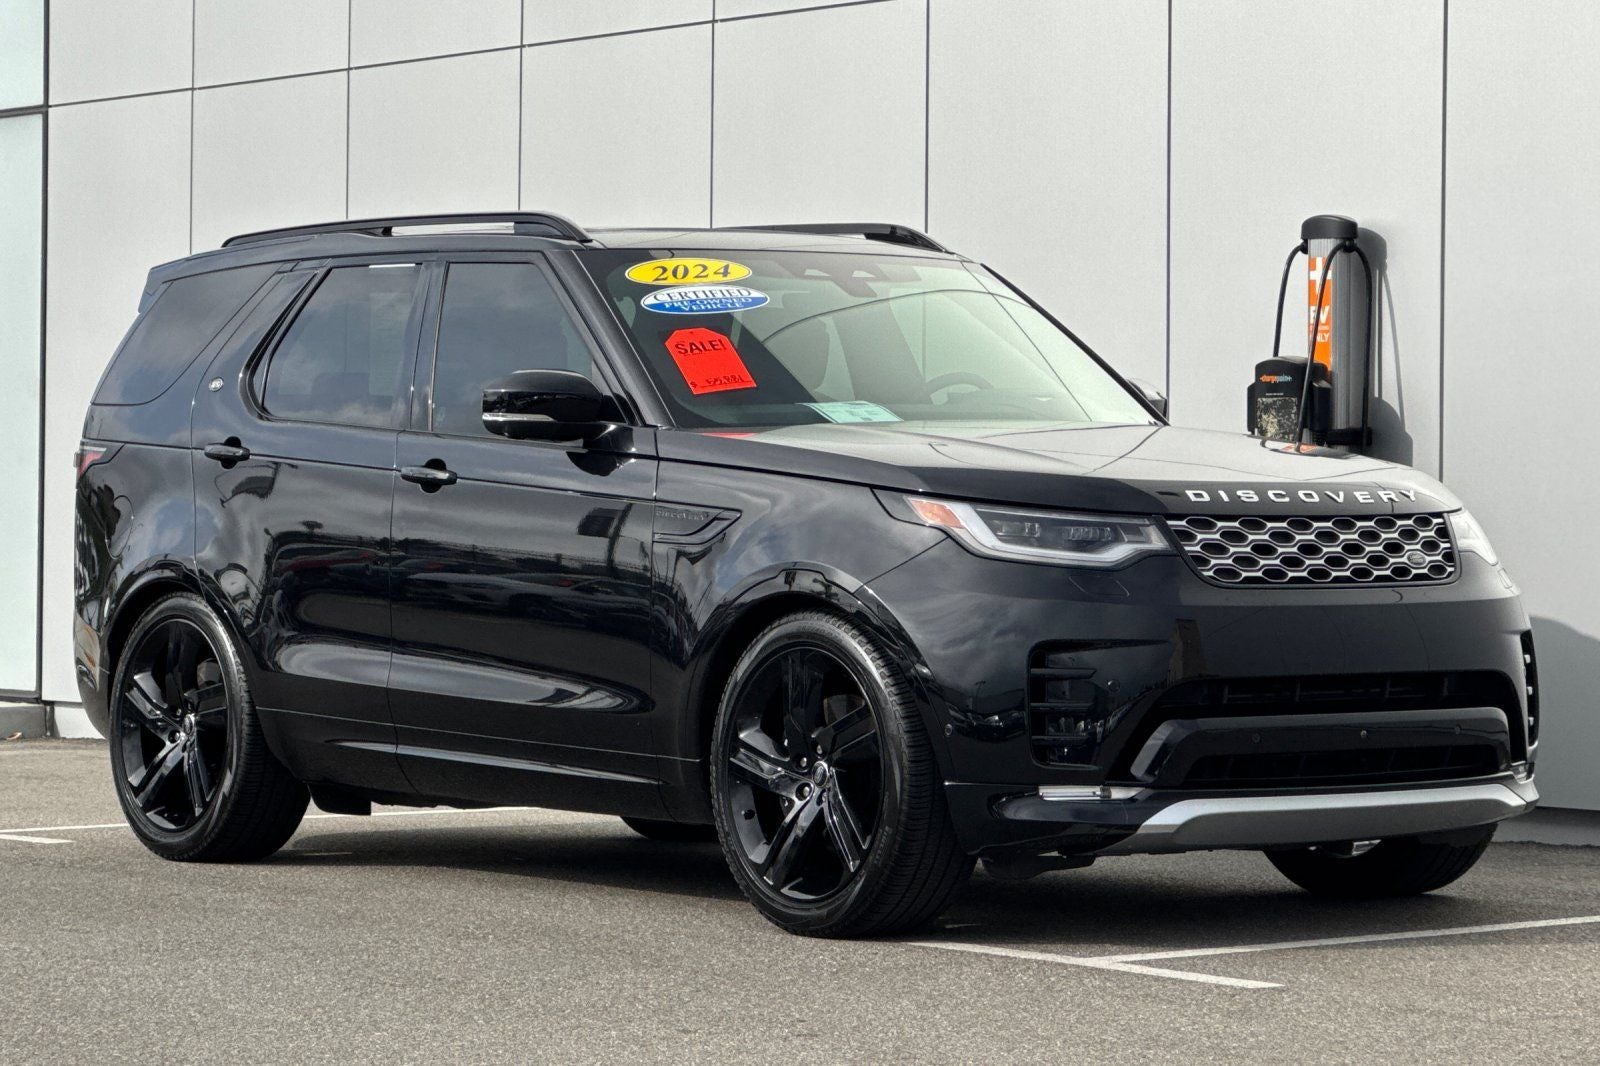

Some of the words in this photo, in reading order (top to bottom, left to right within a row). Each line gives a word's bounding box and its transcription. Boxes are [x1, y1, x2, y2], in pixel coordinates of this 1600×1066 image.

[652, 263, 731, 282] 2024
[653, 288, 752, 302] CERTIFIED
[664, 297, 753, 308] PRE-OWNED
[681, 302, 744, 311] VEHICLE
[675, 339, 727, 355] SALE!
[1185, 489, 1418, 503] DISCOVERY
